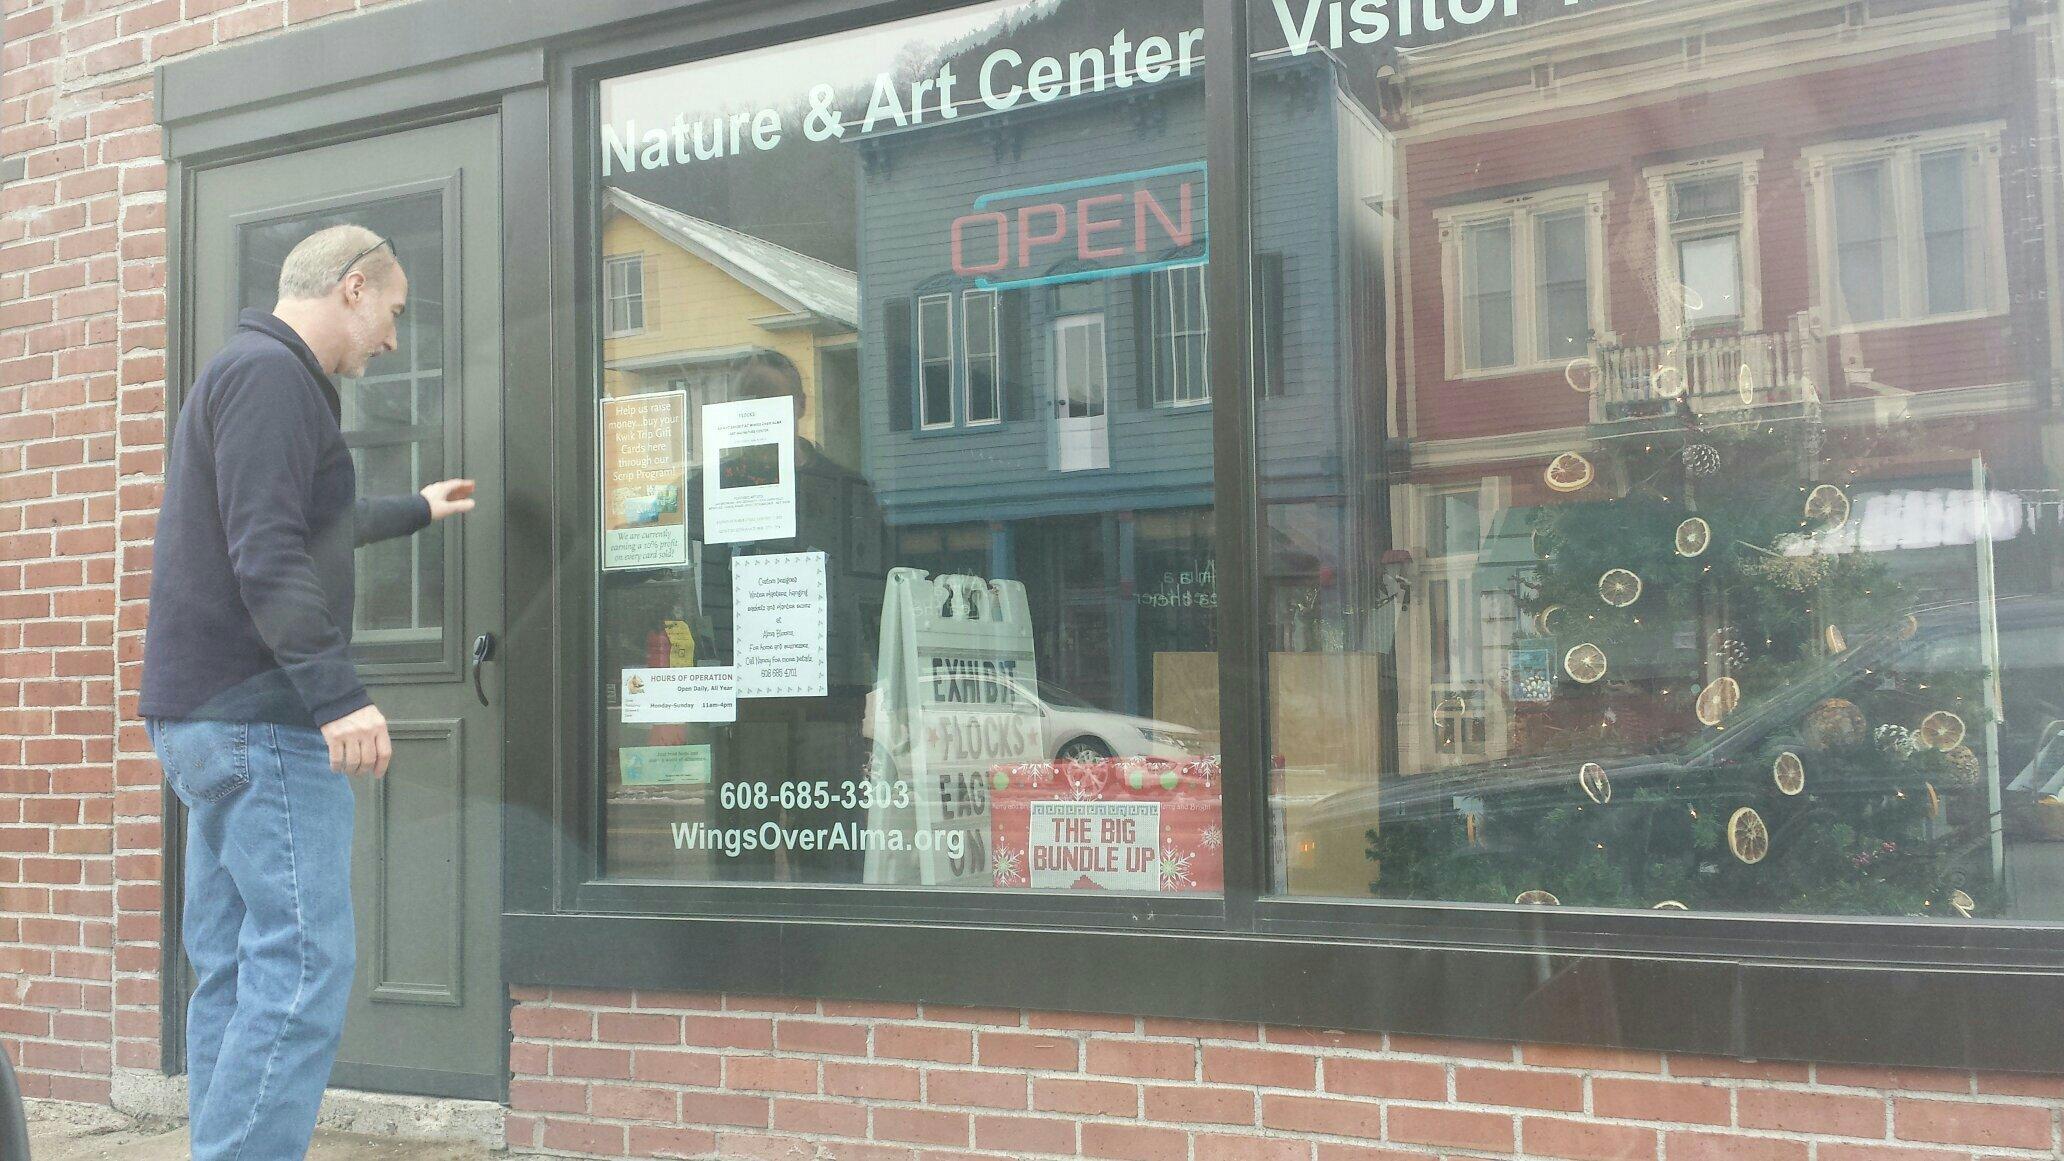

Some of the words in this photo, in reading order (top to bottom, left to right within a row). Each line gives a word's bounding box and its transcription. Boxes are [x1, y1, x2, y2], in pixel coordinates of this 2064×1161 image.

[602, 107, 783, 177] Nature
[803, 83, 845, 142] &
[861, 62, 957, 133] Art
[979, 28, 1205, 111] Center
[951, 183, 1193, 277] OPEN
[615, 404, 636, 415] Help
[639, 405, 648, 413] us
[651, 403, 671, 412] raise
[660, 415, 679, 426] your
[615, 432, 635, 442] Kwik
[637, 428, 654, 440] Trip
[655, 426, 671, 438] Gift
[621, 443, 645, 454] Cards
[648, 442, 666, 452] here
[618, 456, 652, 469] through
[654, 456, 669, 464] our
[611, 542, 636, 553] earning
[660, 538, 678, 550] profit
[616, 532, 629, 541] We
[642, 529, 671, 540] currently
[678, 674, 688, 682] OF
[932, 657, 1017, 704] EXHIBIT
[939, 716, 1025, 760] FLOCKS
[720, 780, 909, 810] 608-685-3303
[940, 771, 990, 820] EAG
[671, 821, 965, 860] WingsOverAlma.org
[1052, 817, 1092, 843] THE
[1100, 817, 1136, 844] BIG
[1033, 845, 1119, 872] BUNDLE
[1126, 847, 1155, 872] UP
